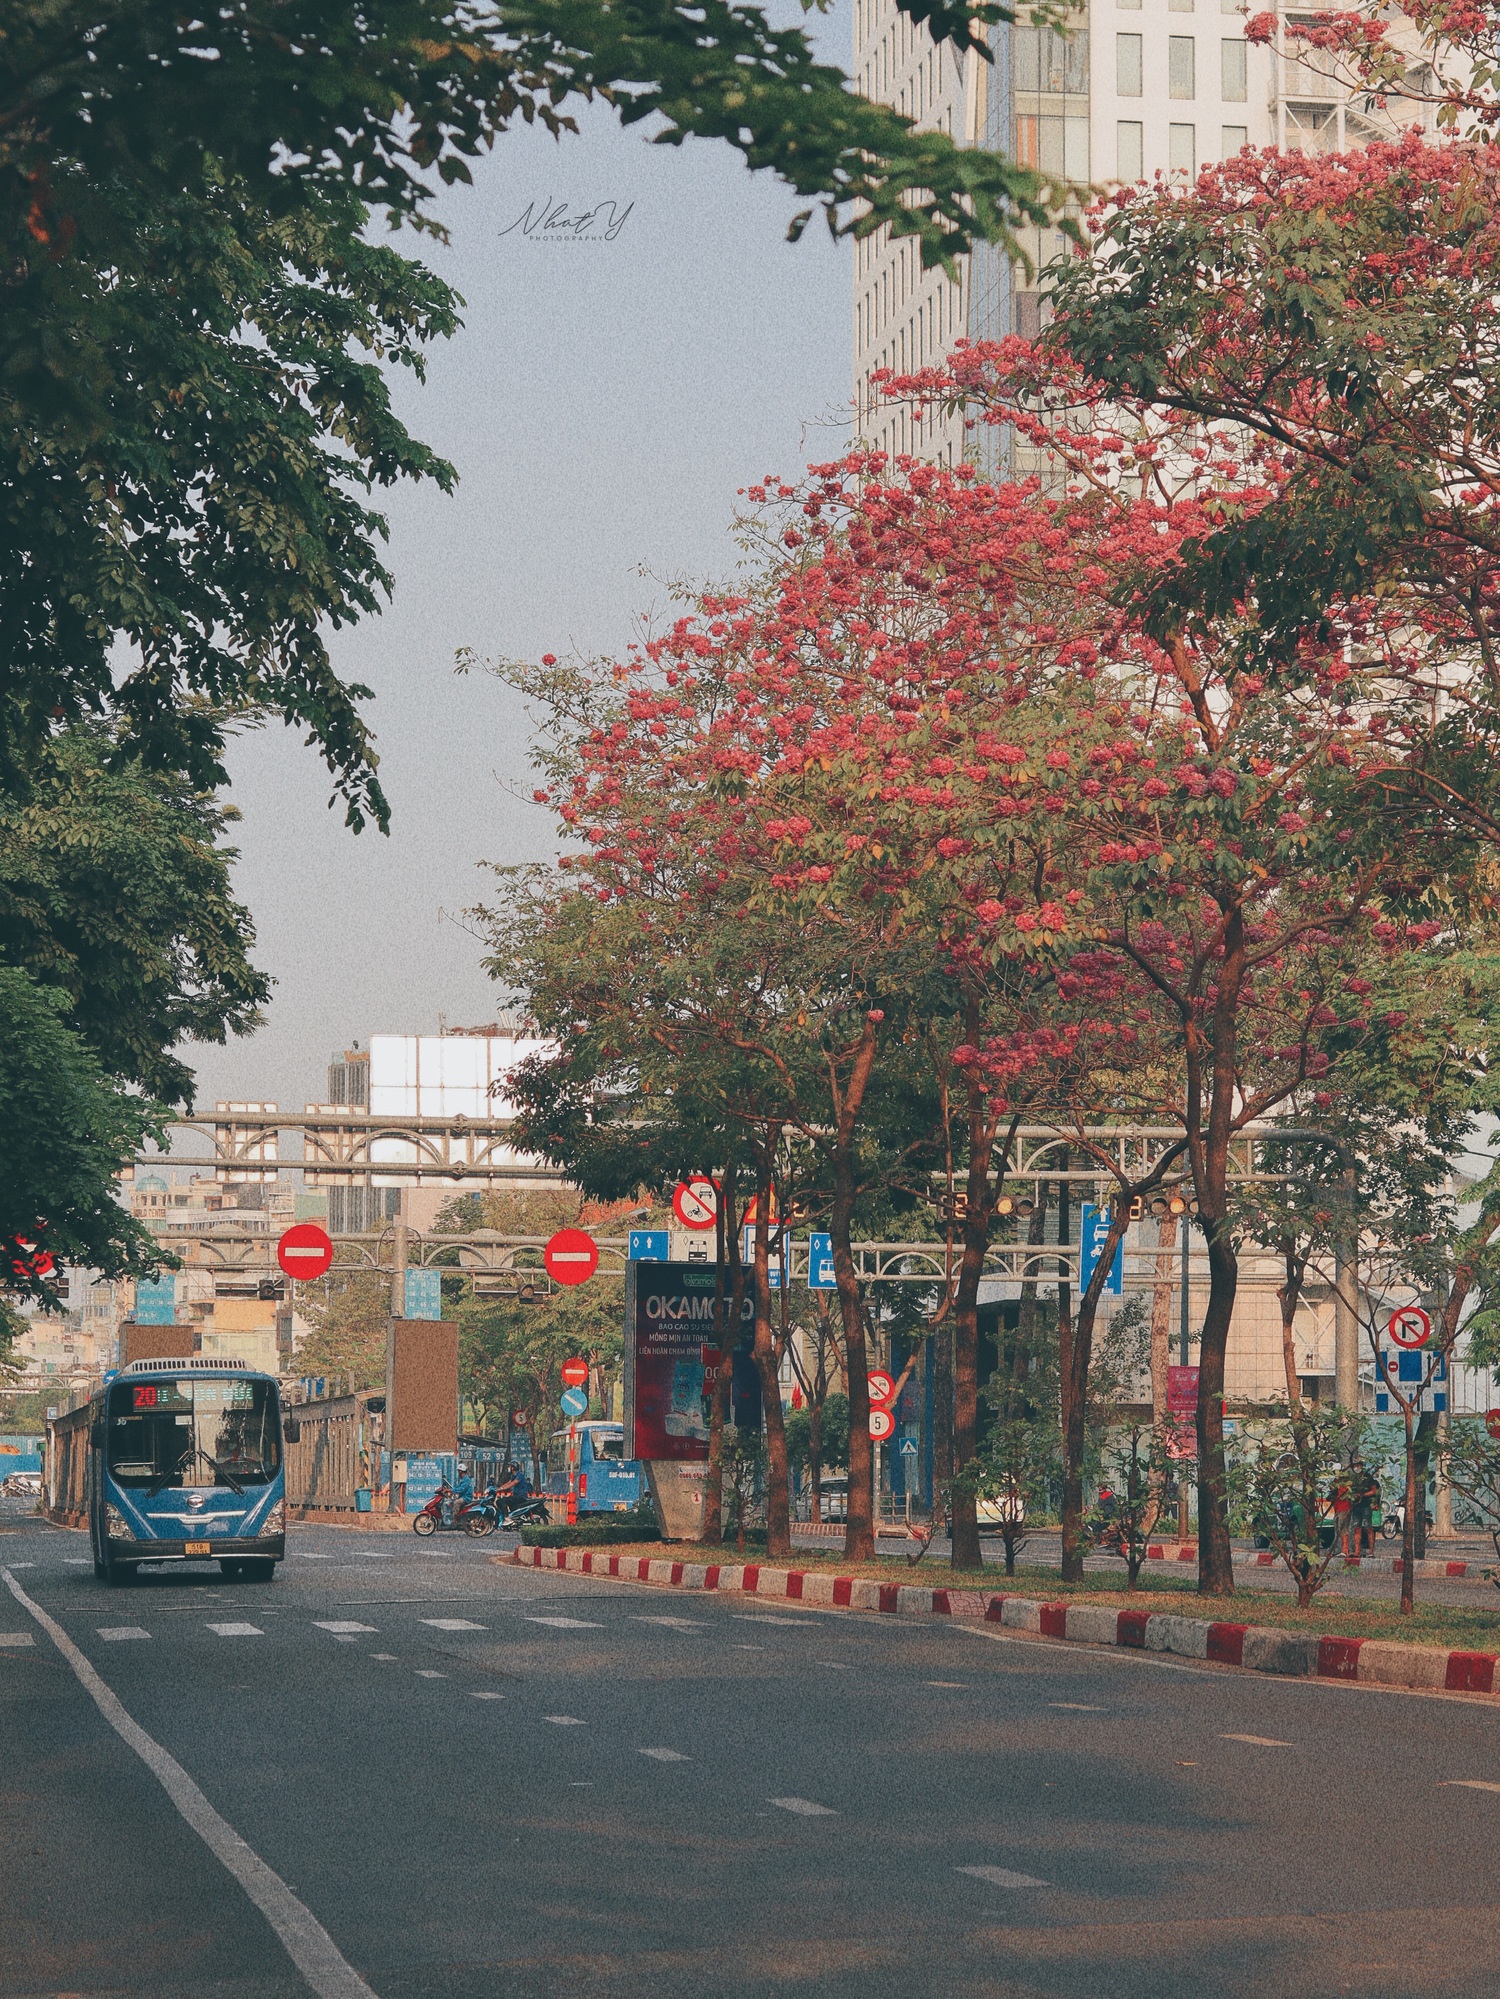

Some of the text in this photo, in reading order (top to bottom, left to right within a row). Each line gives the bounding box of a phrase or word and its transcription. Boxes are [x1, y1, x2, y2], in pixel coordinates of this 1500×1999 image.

[659, 1323, 674, 1331] BAO
[674, 1323, 689, 1331] CAO
[682, 1335, 691, 1343] AN
[639, 1346, 652, 1355] LIÊN
[134, 1386, 156, 1406] 20
[518, 1413, 524, 1423] 5
[873, 1415, 882, 1430] 5
[482, 1452, 491, 1461] 52
[495, 1452, 505, 1461] 93
[694, 1493, 699, 1502] 1
